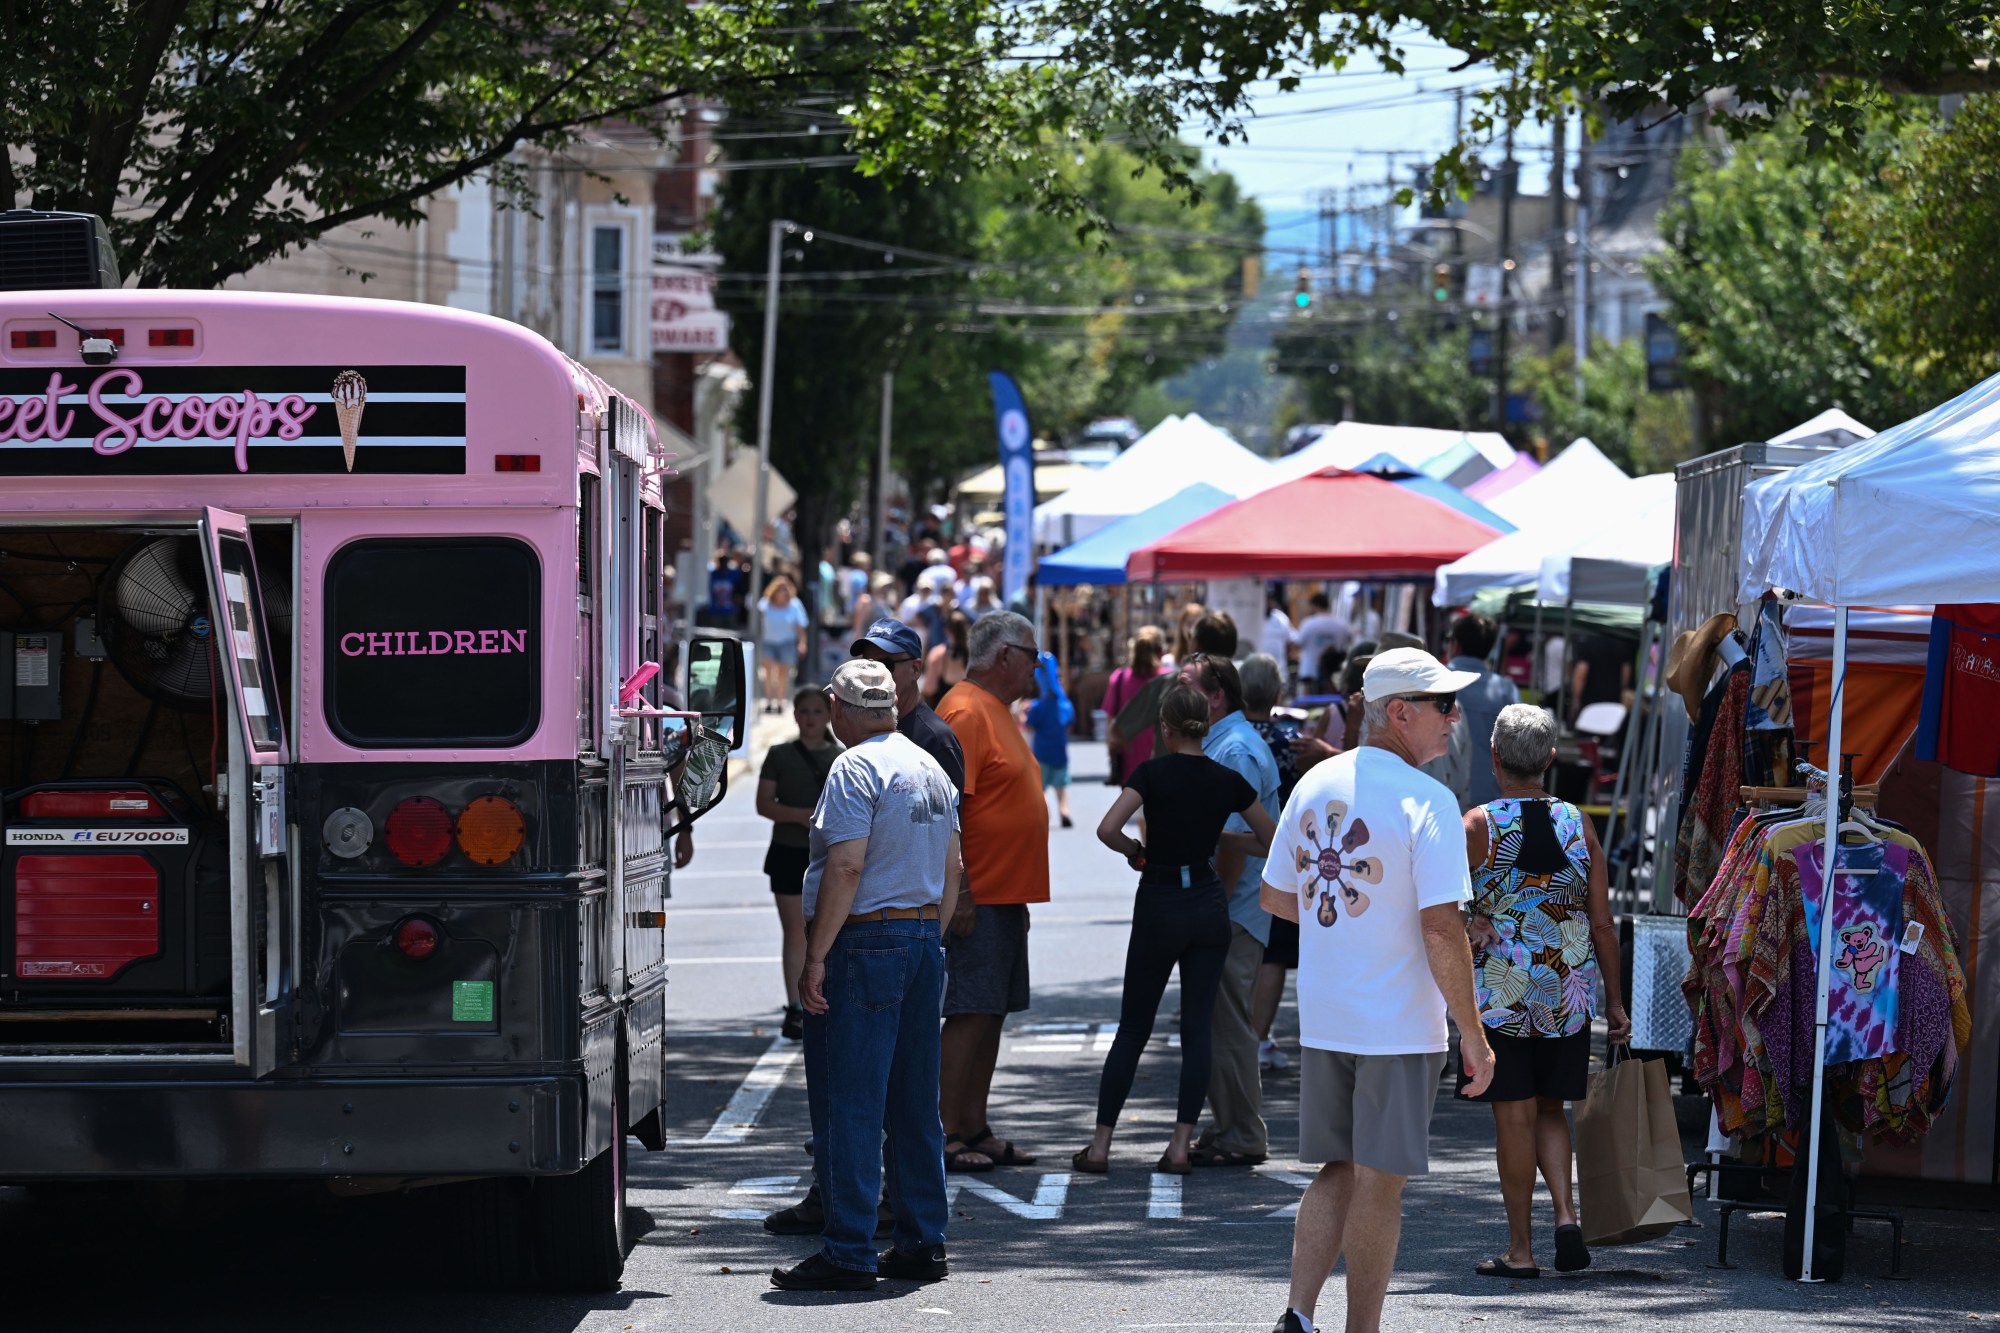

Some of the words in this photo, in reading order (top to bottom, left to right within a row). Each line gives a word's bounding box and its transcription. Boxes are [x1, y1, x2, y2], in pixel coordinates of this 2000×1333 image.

[88, 368, 317, 472] Scoops
[340, 629, 527, 656] CHILDREN
[12, 833, 65, 841] HONDA
